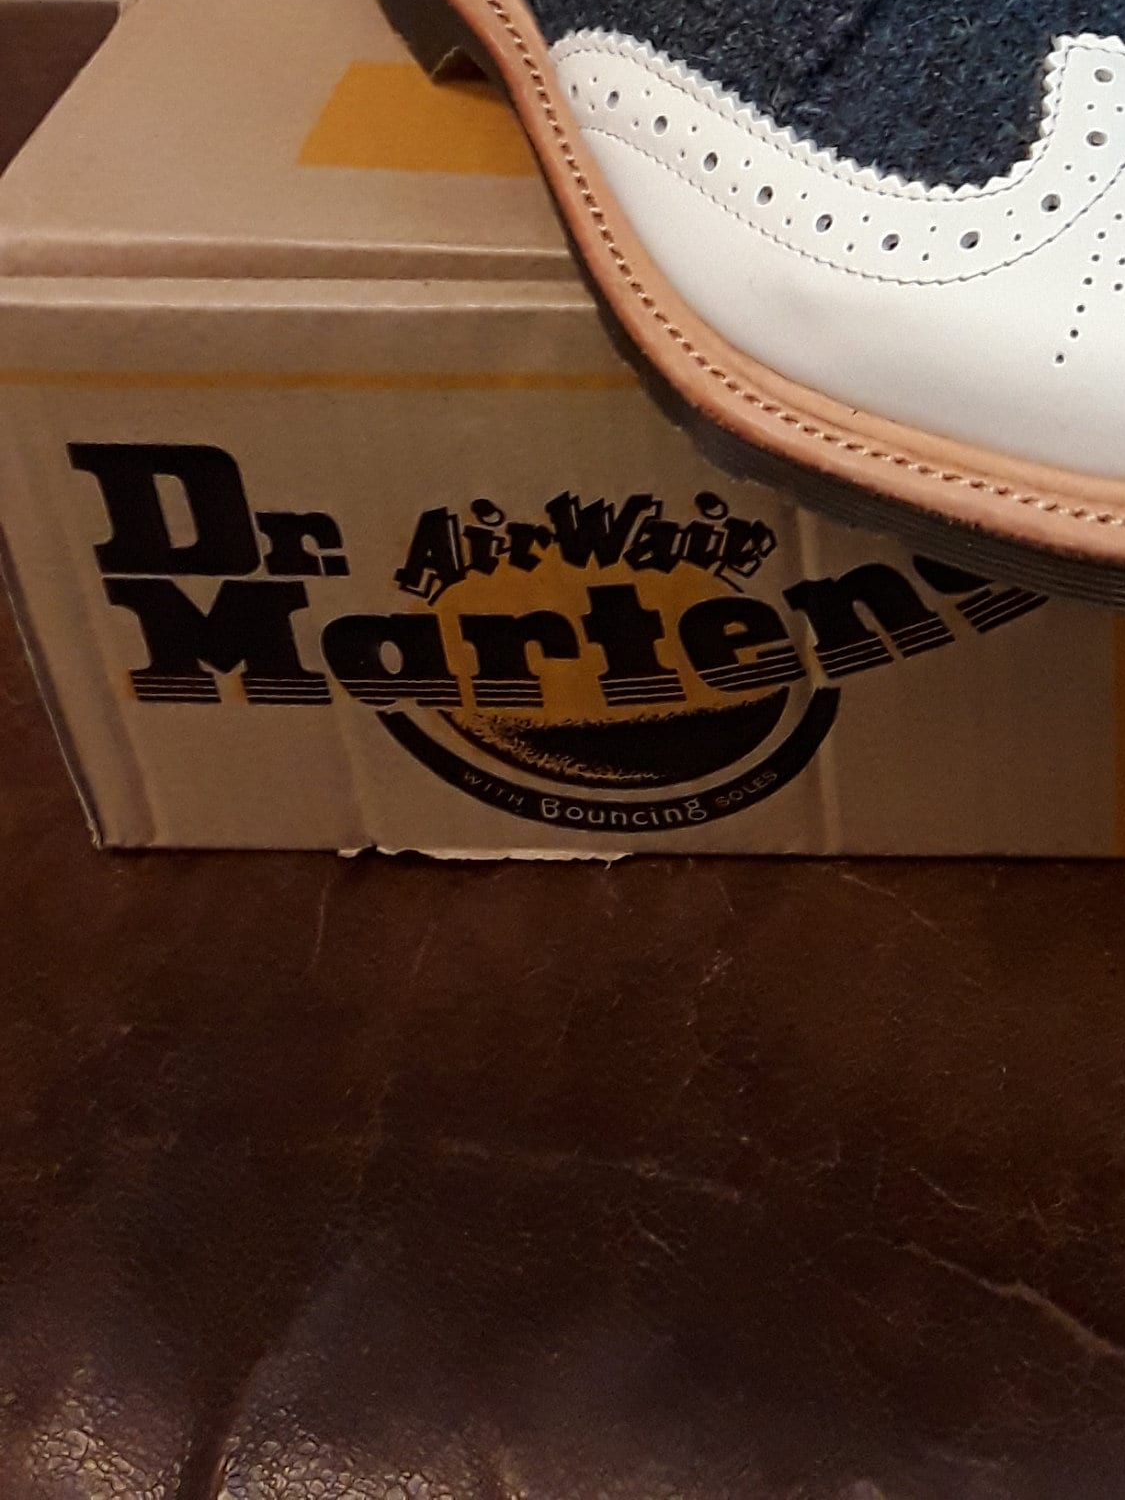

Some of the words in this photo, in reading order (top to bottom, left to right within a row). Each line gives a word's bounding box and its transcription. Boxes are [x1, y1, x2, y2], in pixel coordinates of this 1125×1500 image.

[394, 490, 778, 606] AirWair
[540, 796, 708, 827] Bouncing
[714, 769, 778, 806] SOLES
